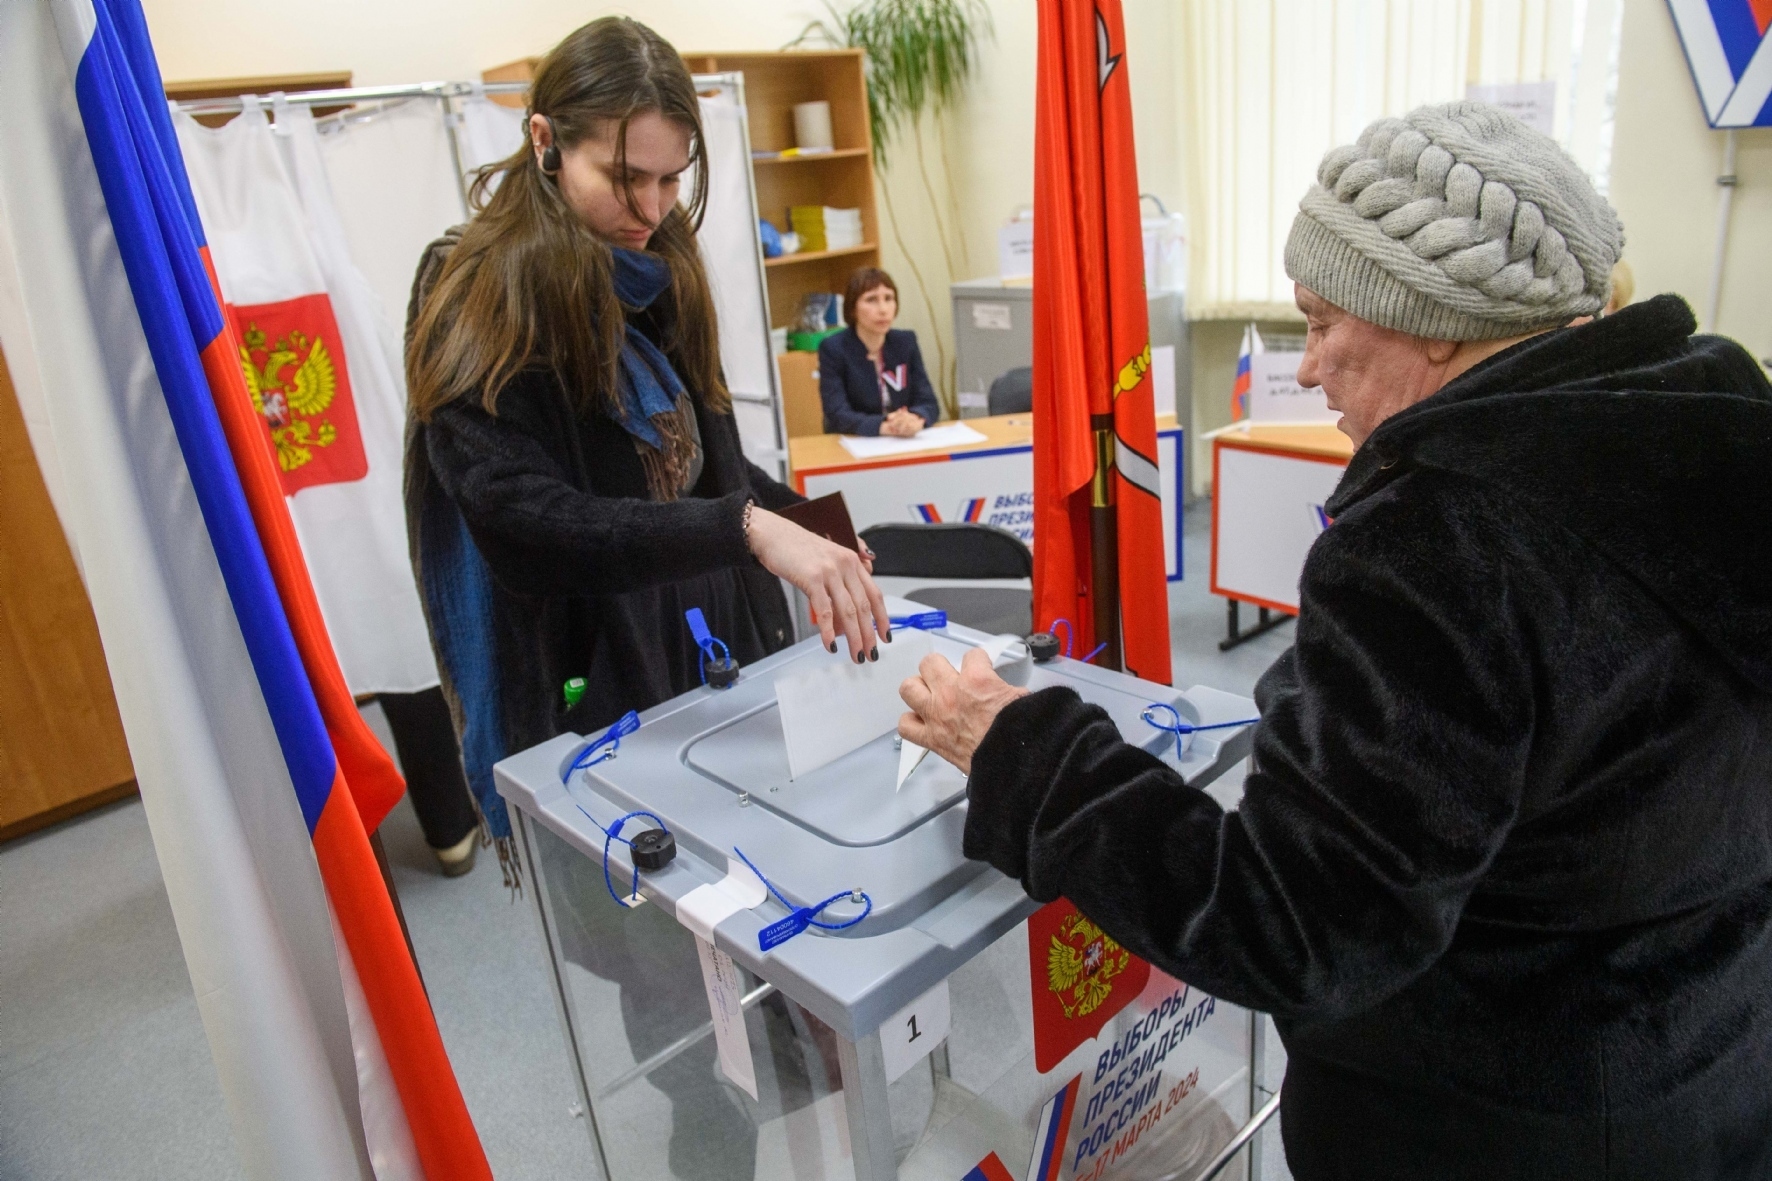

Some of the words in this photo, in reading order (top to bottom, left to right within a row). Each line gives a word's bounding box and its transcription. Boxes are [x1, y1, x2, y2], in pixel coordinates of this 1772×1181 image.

[907, 1014, 922, 1044] 1
[1082, 996, 1216, 1130] ПРЕЗИДЕНТА
[1092, 984, 1190, 1085] ВЫБОРЫ
[1073, 1069, 1163, 1173] РОССИИ
[1111, 1104, 1162, 1165] МАРТА
[1164, 1066, 1200, 1116] 2024
